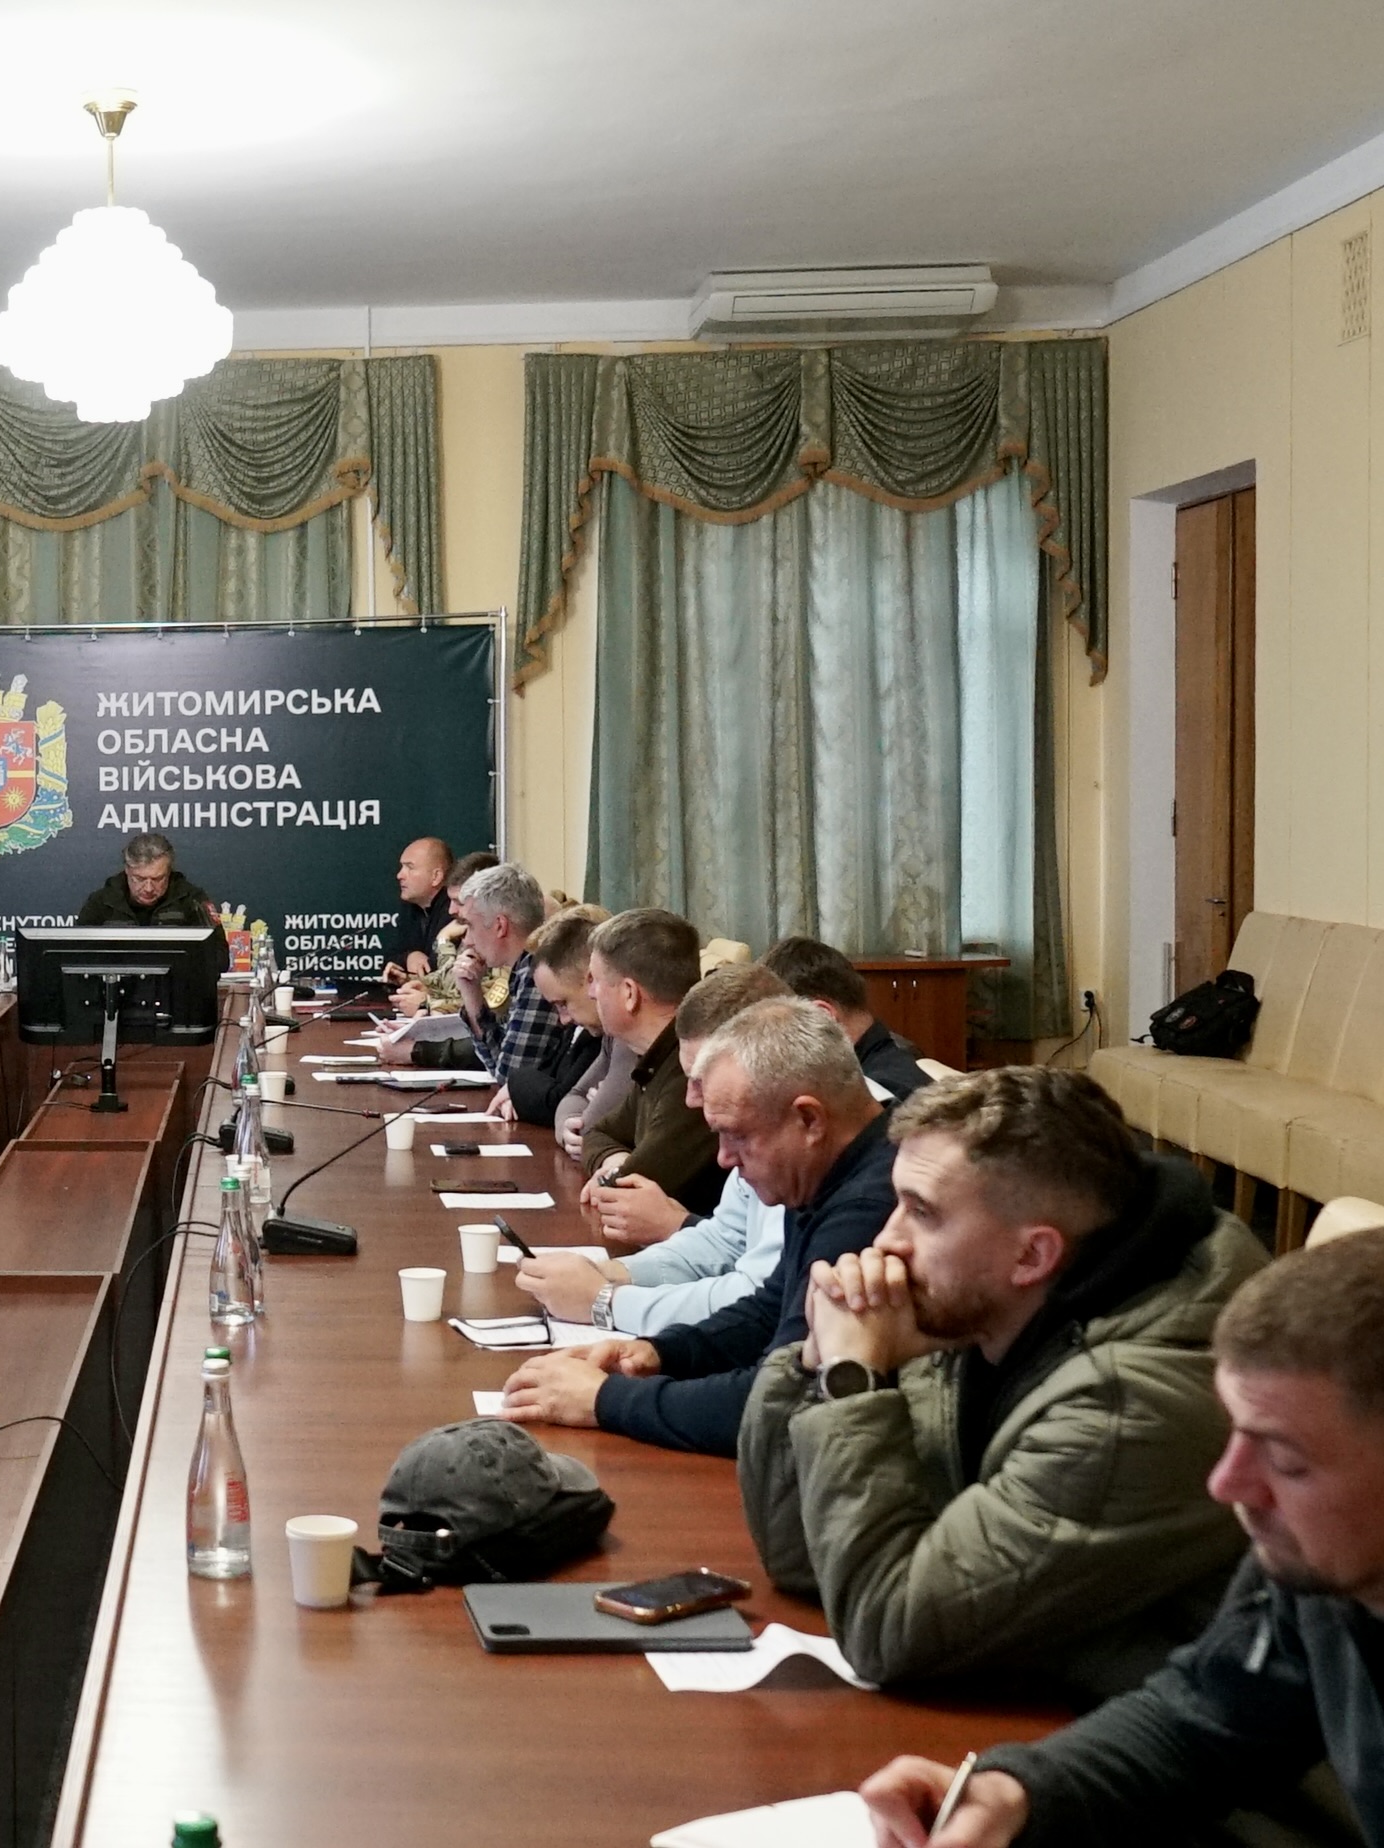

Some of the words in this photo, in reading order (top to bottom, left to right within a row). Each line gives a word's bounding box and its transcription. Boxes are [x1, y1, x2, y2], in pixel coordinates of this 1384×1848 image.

[97, 688, 382, 717] ЖИТОМИРСЬКА
[97, 727, 269, 754] ОБЛАСНА
[98, 760, 302, 792] ВІЙСЬКОВА
[97, 800, 381, 833] АДМІНІСТРАЦІЯ
[284, 934, 383, 951] ОБЛАСНА
